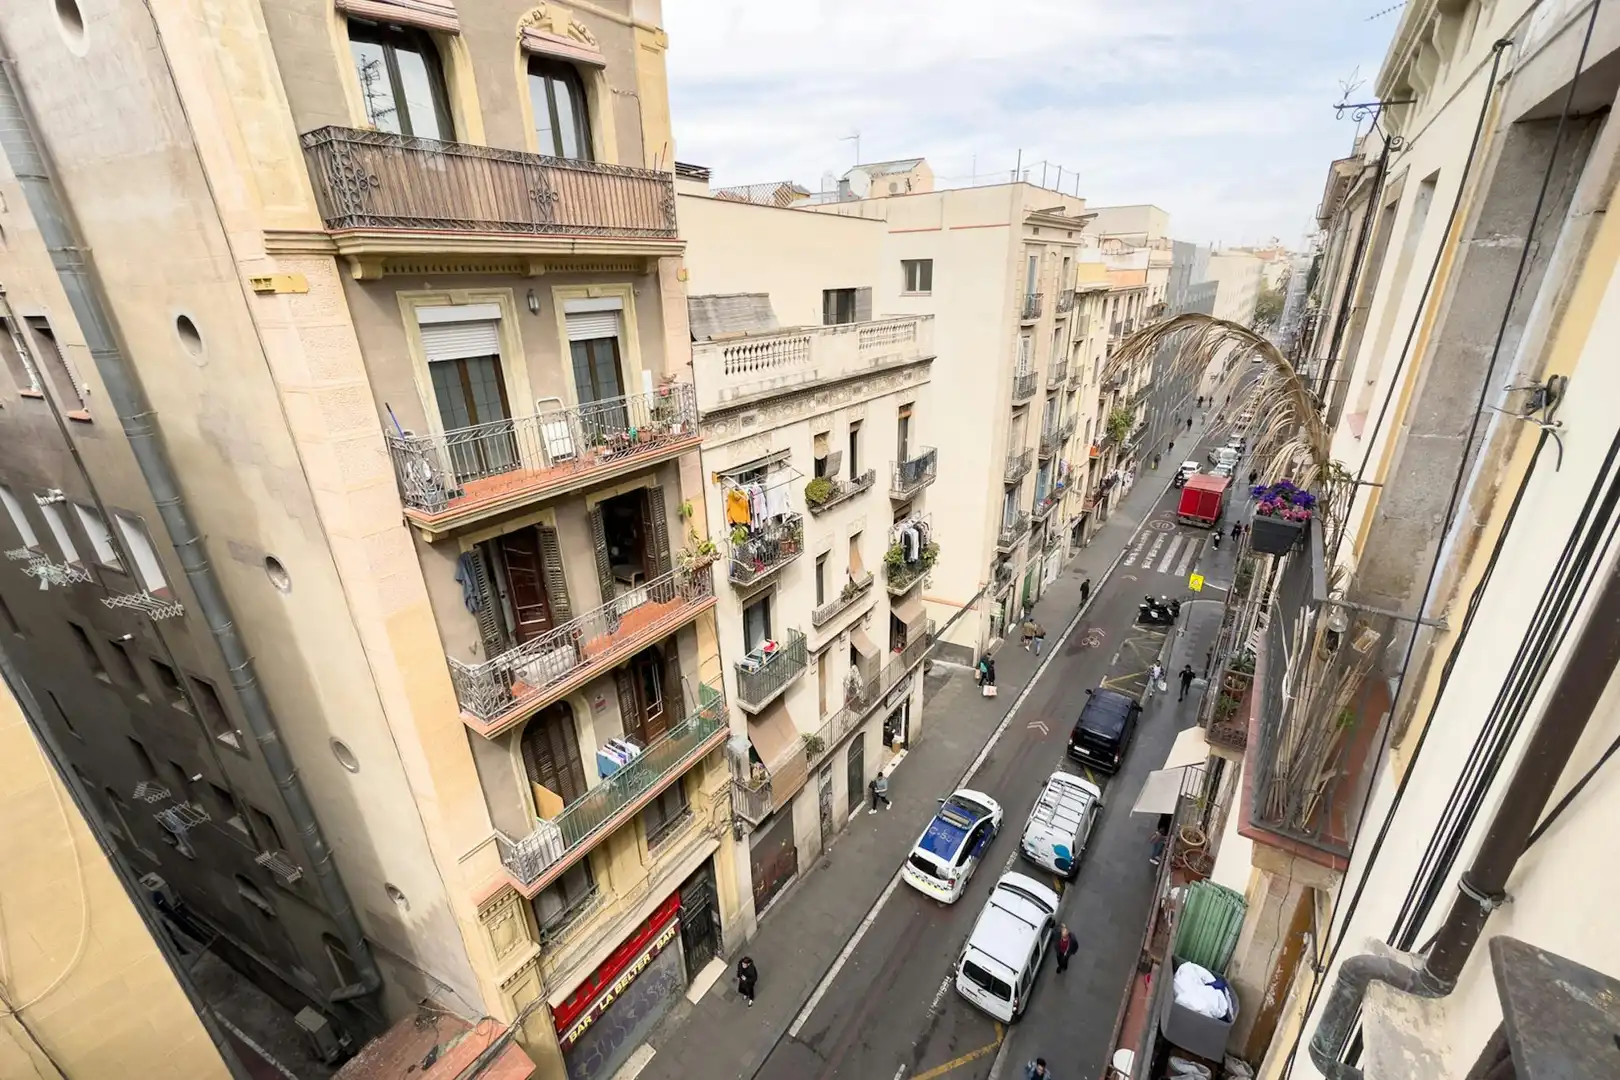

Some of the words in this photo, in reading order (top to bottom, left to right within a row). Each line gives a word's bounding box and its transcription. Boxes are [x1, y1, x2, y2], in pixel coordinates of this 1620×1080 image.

[568, 1015, 592, 1042] BAR
[599, 993, 614, 1010] LA
[614, 953, 651, 994] BELTER
[656, 927, 676, 950] BAR
